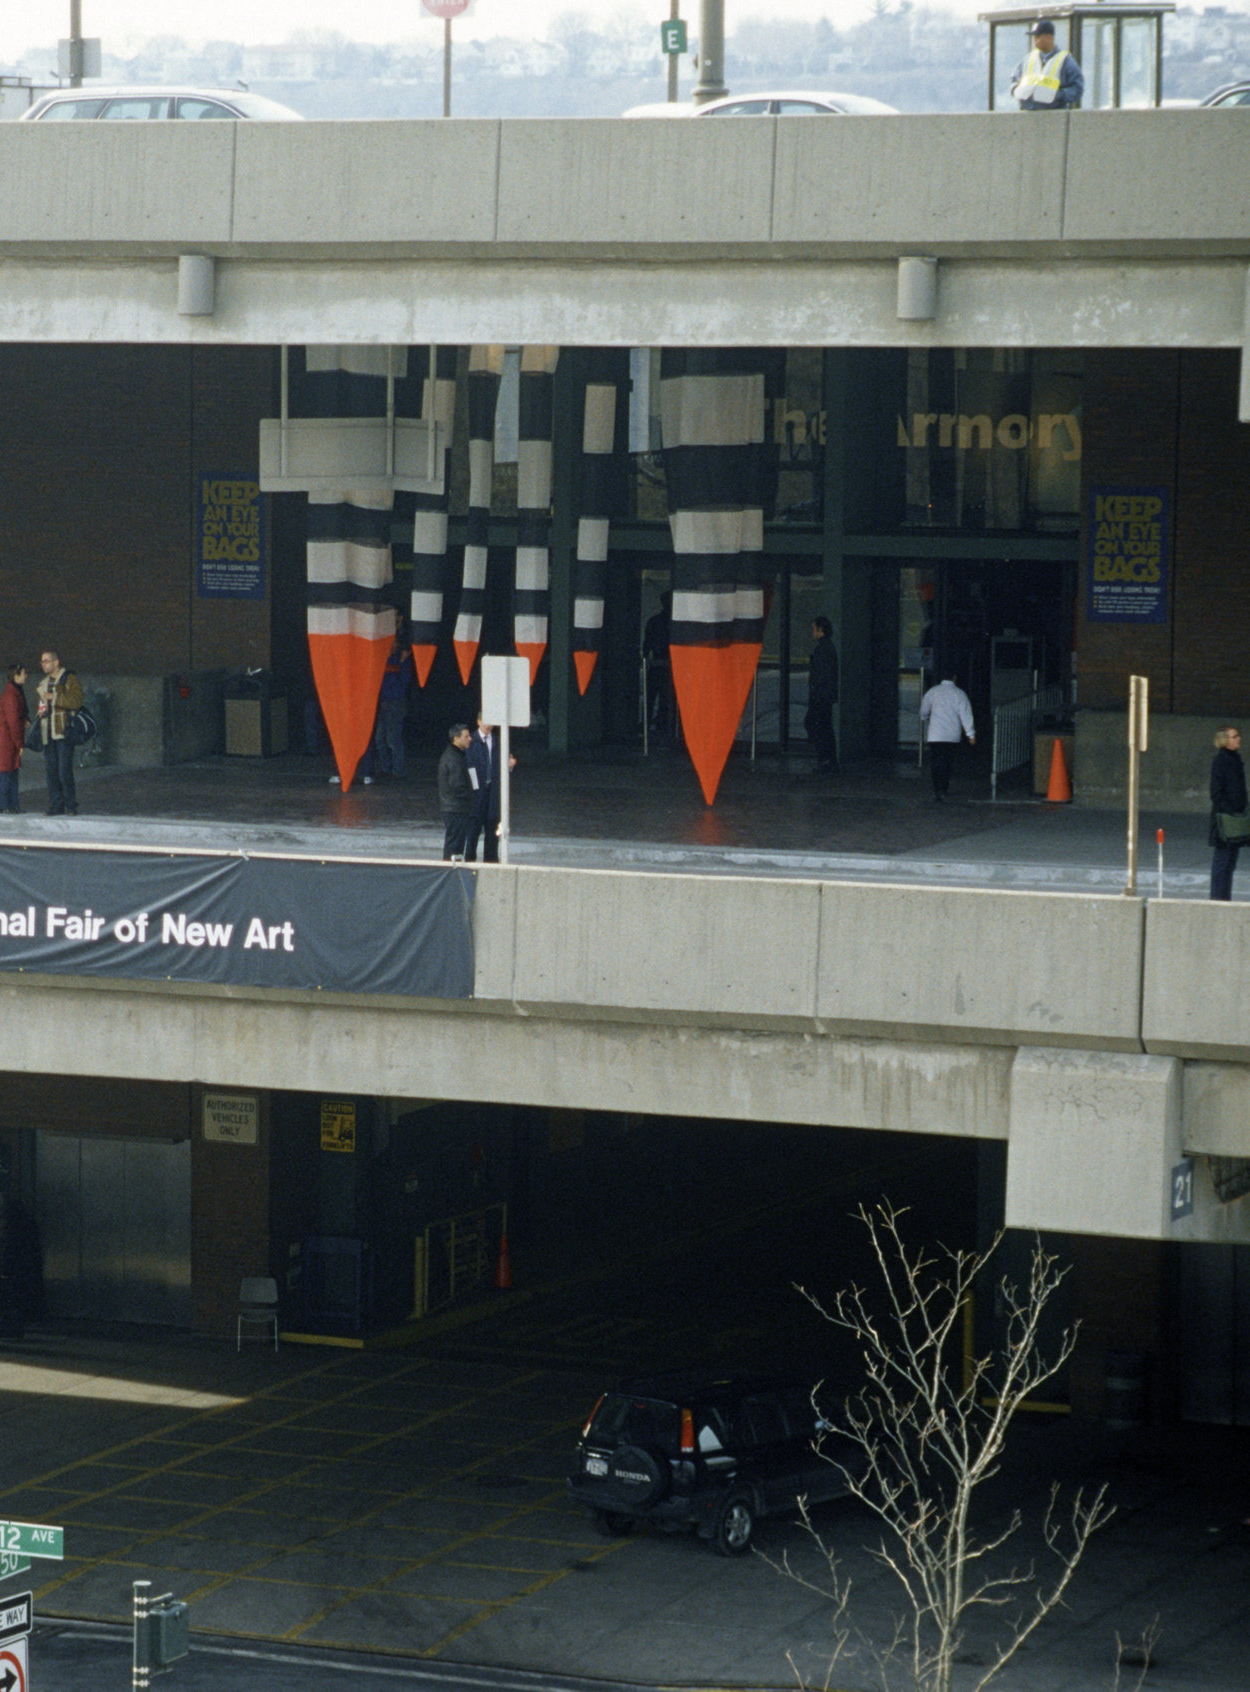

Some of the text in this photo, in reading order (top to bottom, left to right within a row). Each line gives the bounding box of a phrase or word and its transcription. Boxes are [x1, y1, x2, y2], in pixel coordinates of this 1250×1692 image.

[667, 29, 680, 49] E
[203, 480, 260, 505] KEEP
[205, 505, 260, 522] AN EYE
[1095, 495, 1163, 522] KEEP
[203, 521, 260, 537] ON YOUR
[1096, 522, 1161, 540] AN EYE
[203, 536, 260, 562] BAGS
[1095, 540, 1161, 555] ON YOUR
[1093, 555, 1161, 582] BAGS
[46, 906, 105, 941] Fair
[114, 912, 149, 943] of
[162, 913, 233, 947] New
[244, 917, 295, 951] Art
[206, 1099, 255, 1112] AUTHORIZED
[212, 1112, 249, 1124] VEHICLES
[220, 1125, 240, 1136] ONLY
[1174, 1171, 1192, 1208] 21
[614, 1469, 651, 1482] HONDA
[31, 1529, 55, 1544] AVE
[6, 1605, 25, 1626] WAY
